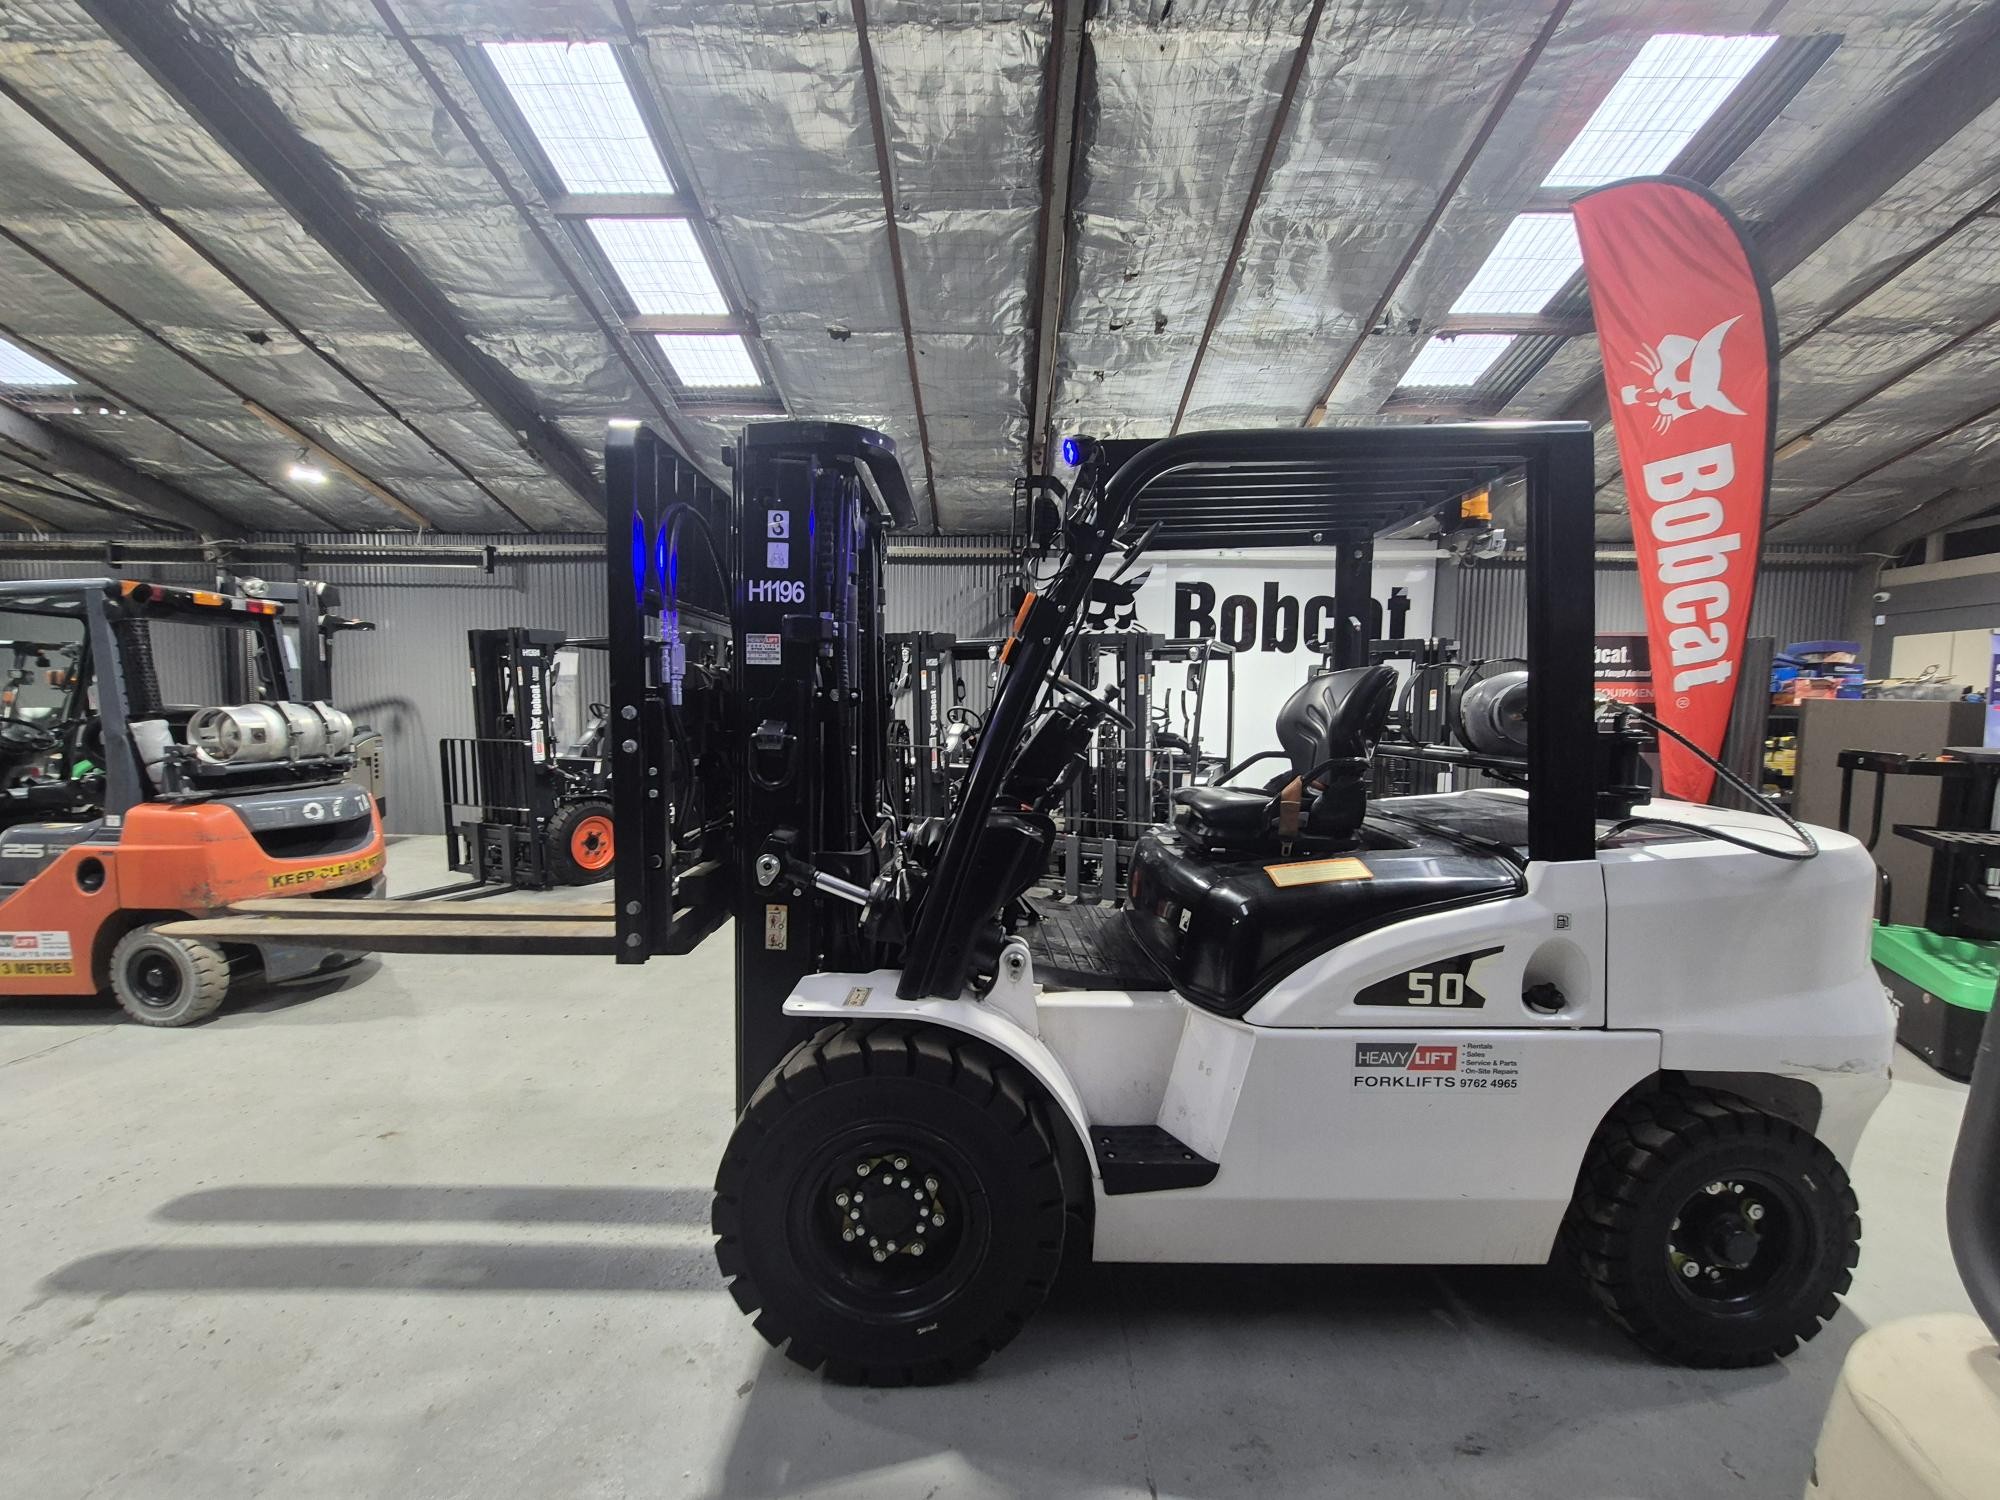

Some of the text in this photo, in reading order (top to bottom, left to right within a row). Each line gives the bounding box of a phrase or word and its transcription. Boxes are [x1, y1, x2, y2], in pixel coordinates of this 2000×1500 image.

[1642, 442, 1742, 693] Bobcat
[748, 580, 805, 603] H1196
[1594, 646, 1627, 664] bcat
[530, 684, 542, 716] Bobcat
[1594, 688, 1655, 698] QUIPMEN
[1, 843, 45, 858] 25
[271, 870, 316, 888] KEEP
[1, 962, 73, 975] 3 METRES
[1407, 971, 1465, 1006] 50
[1357, 1051, 1453, 1065] HEAVY LIFT
[1354, 1076, 1518, 1089] FORKLIFTS 9762 4965
